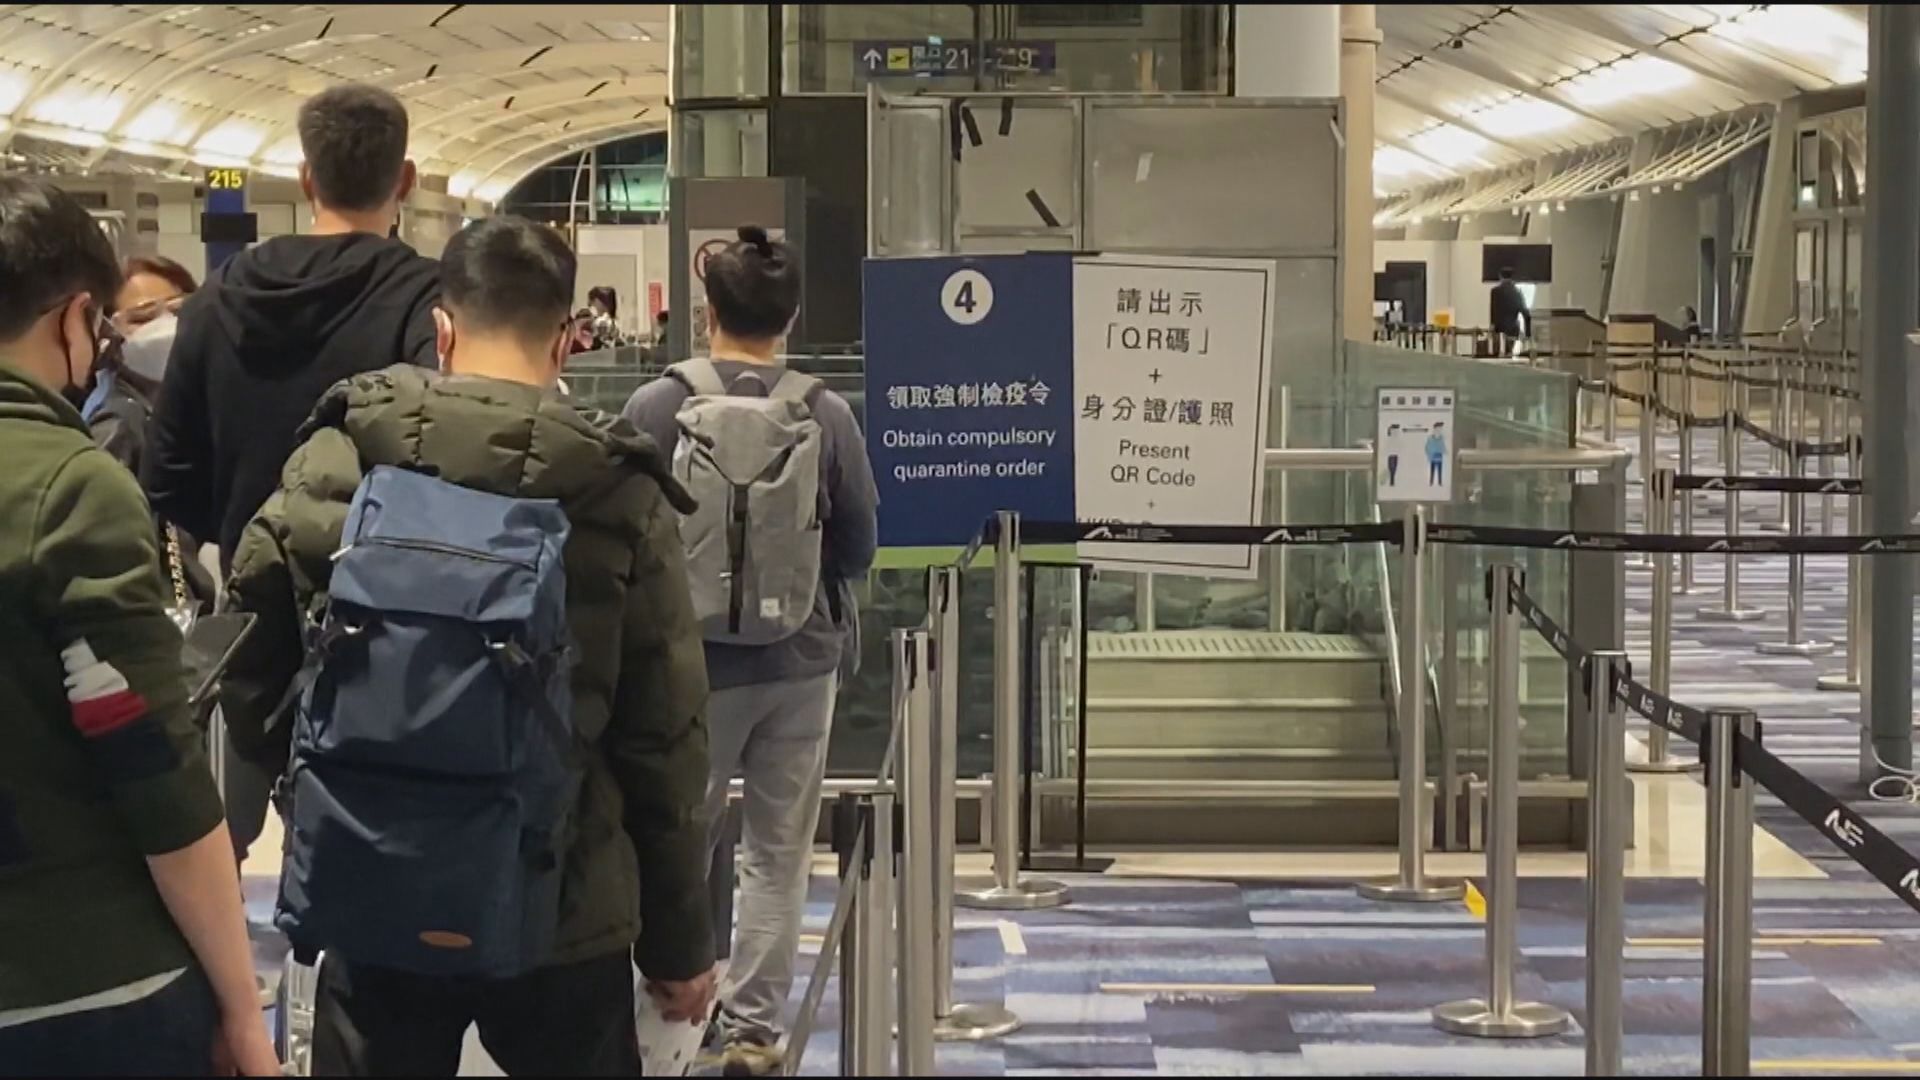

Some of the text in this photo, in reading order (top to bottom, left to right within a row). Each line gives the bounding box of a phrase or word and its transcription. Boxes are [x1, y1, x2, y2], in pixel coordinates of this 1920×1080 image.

[945, 48, 969, 69] 21
[209, 169, 243, 189] 215
[954, 280, 977, 313] 4
[1116, 287, 1203, 317] 請出示
[886, 380, 1051, 409] 領取強制檢疫令
[882, 426, 1056, 449] Obtain compulsory
[1119, 439, 1190, 460] Present
[893, 458, 1046, 482] quarantine order
[1110, 464, 1196, 487] QR Code
